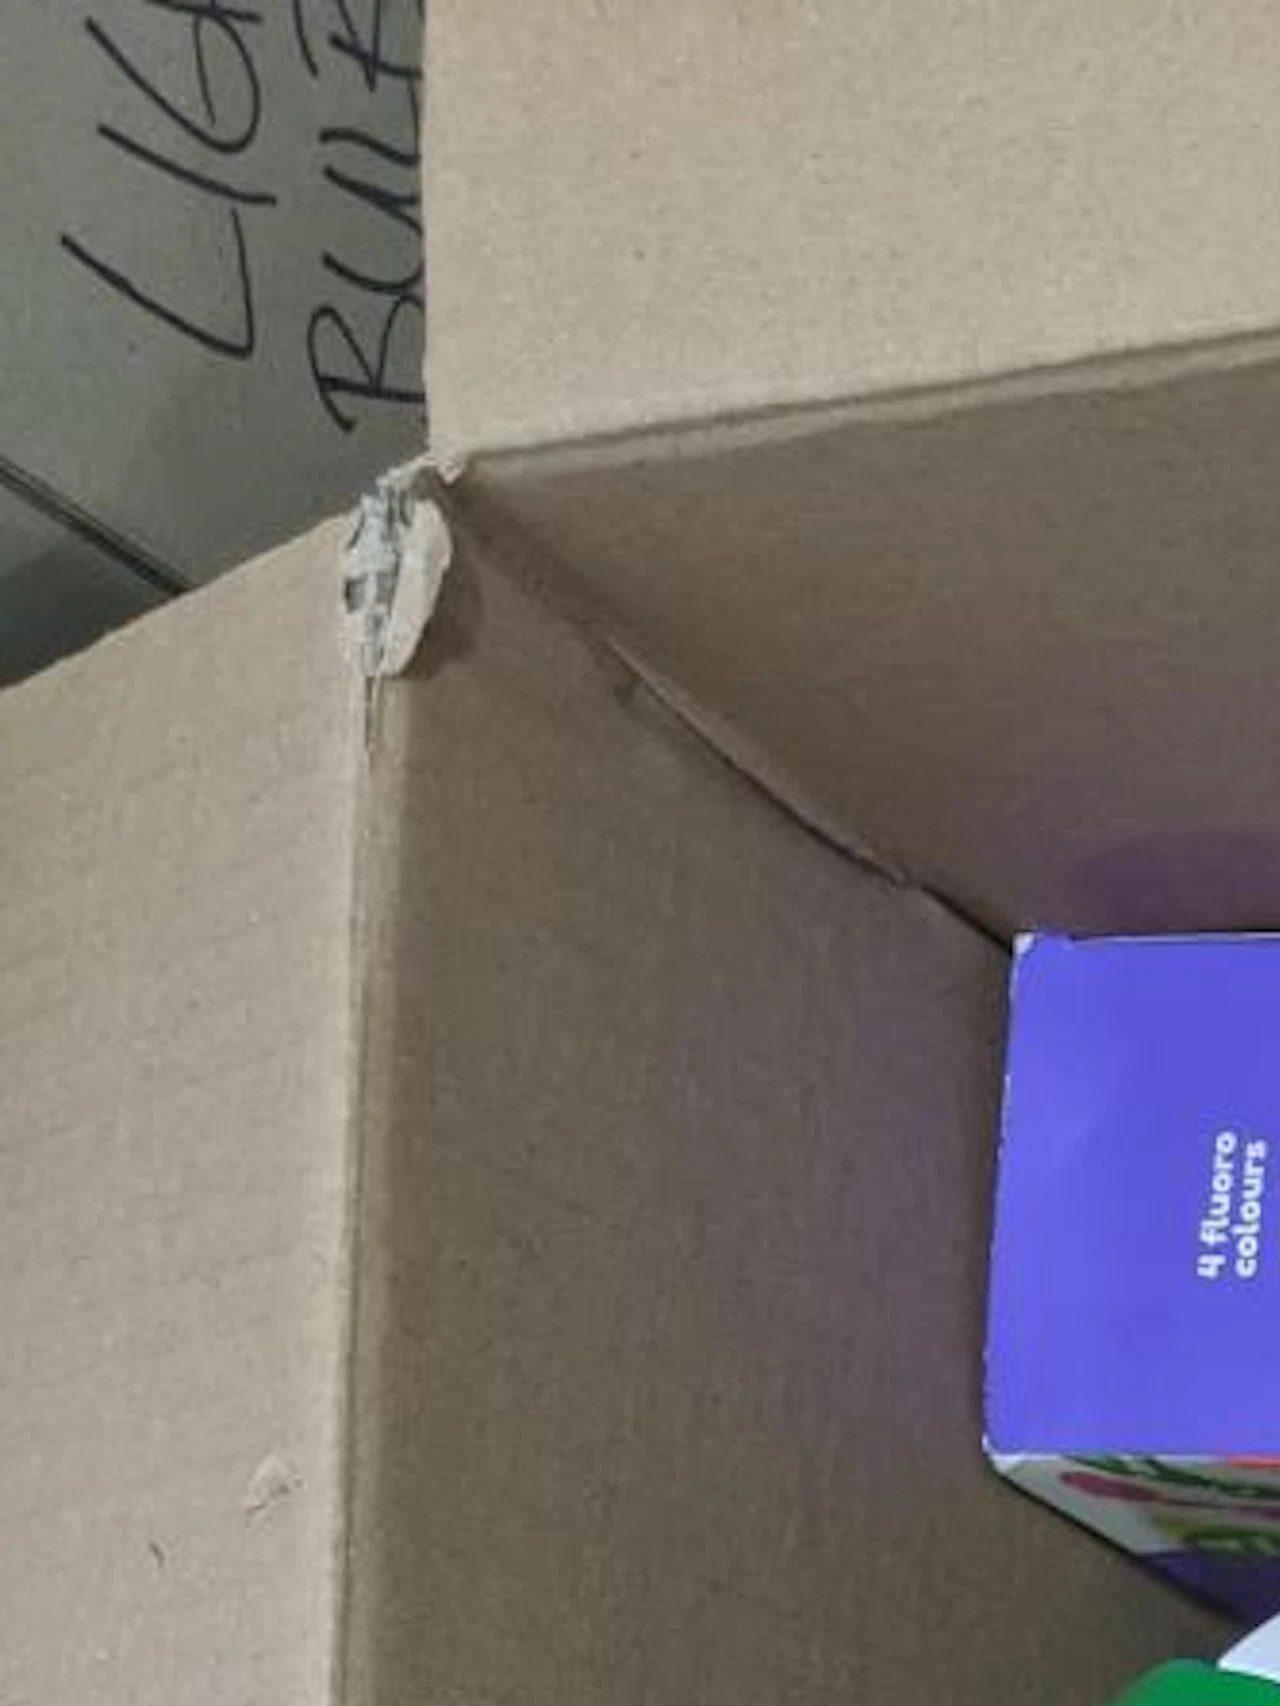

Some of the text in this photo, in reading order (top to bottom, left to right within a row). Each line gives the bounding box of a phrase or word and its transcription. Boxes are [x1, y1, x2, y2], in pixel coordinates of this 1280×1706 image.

[61, 0, 278, 360] LIG
[1197, 1131, 1238, 1279] 4 fluoro
[1231, 1138, 1267, 1278] colours
